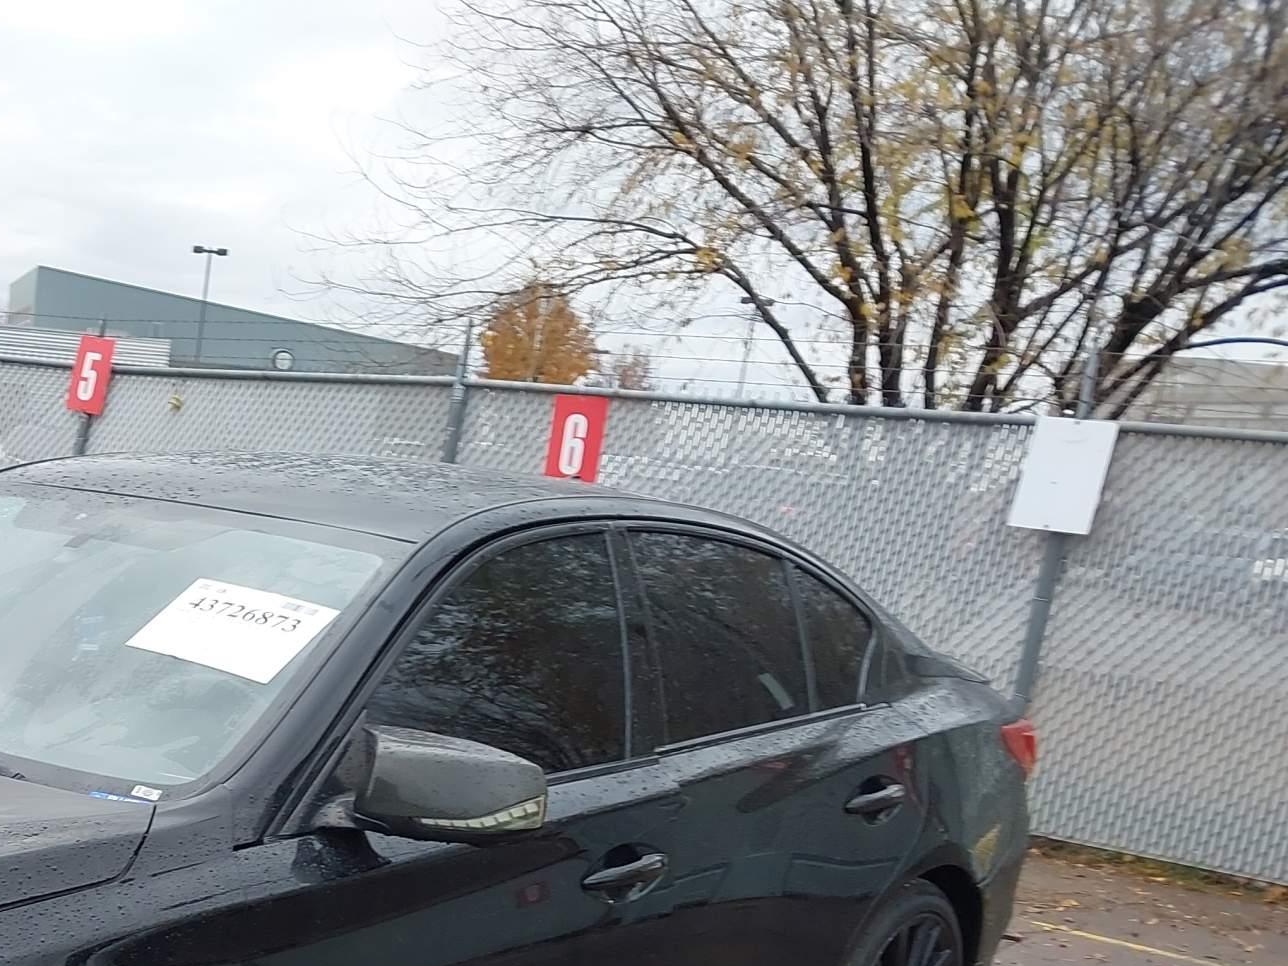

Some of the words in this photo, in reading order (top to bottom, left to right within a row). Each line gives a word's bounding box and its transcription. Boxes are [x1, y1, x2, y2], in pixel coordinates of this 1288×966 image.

[76, 352, 102, 401] 5
[558, 413, 589, 475] 6
[189, 597, 301, 632] 43726873
